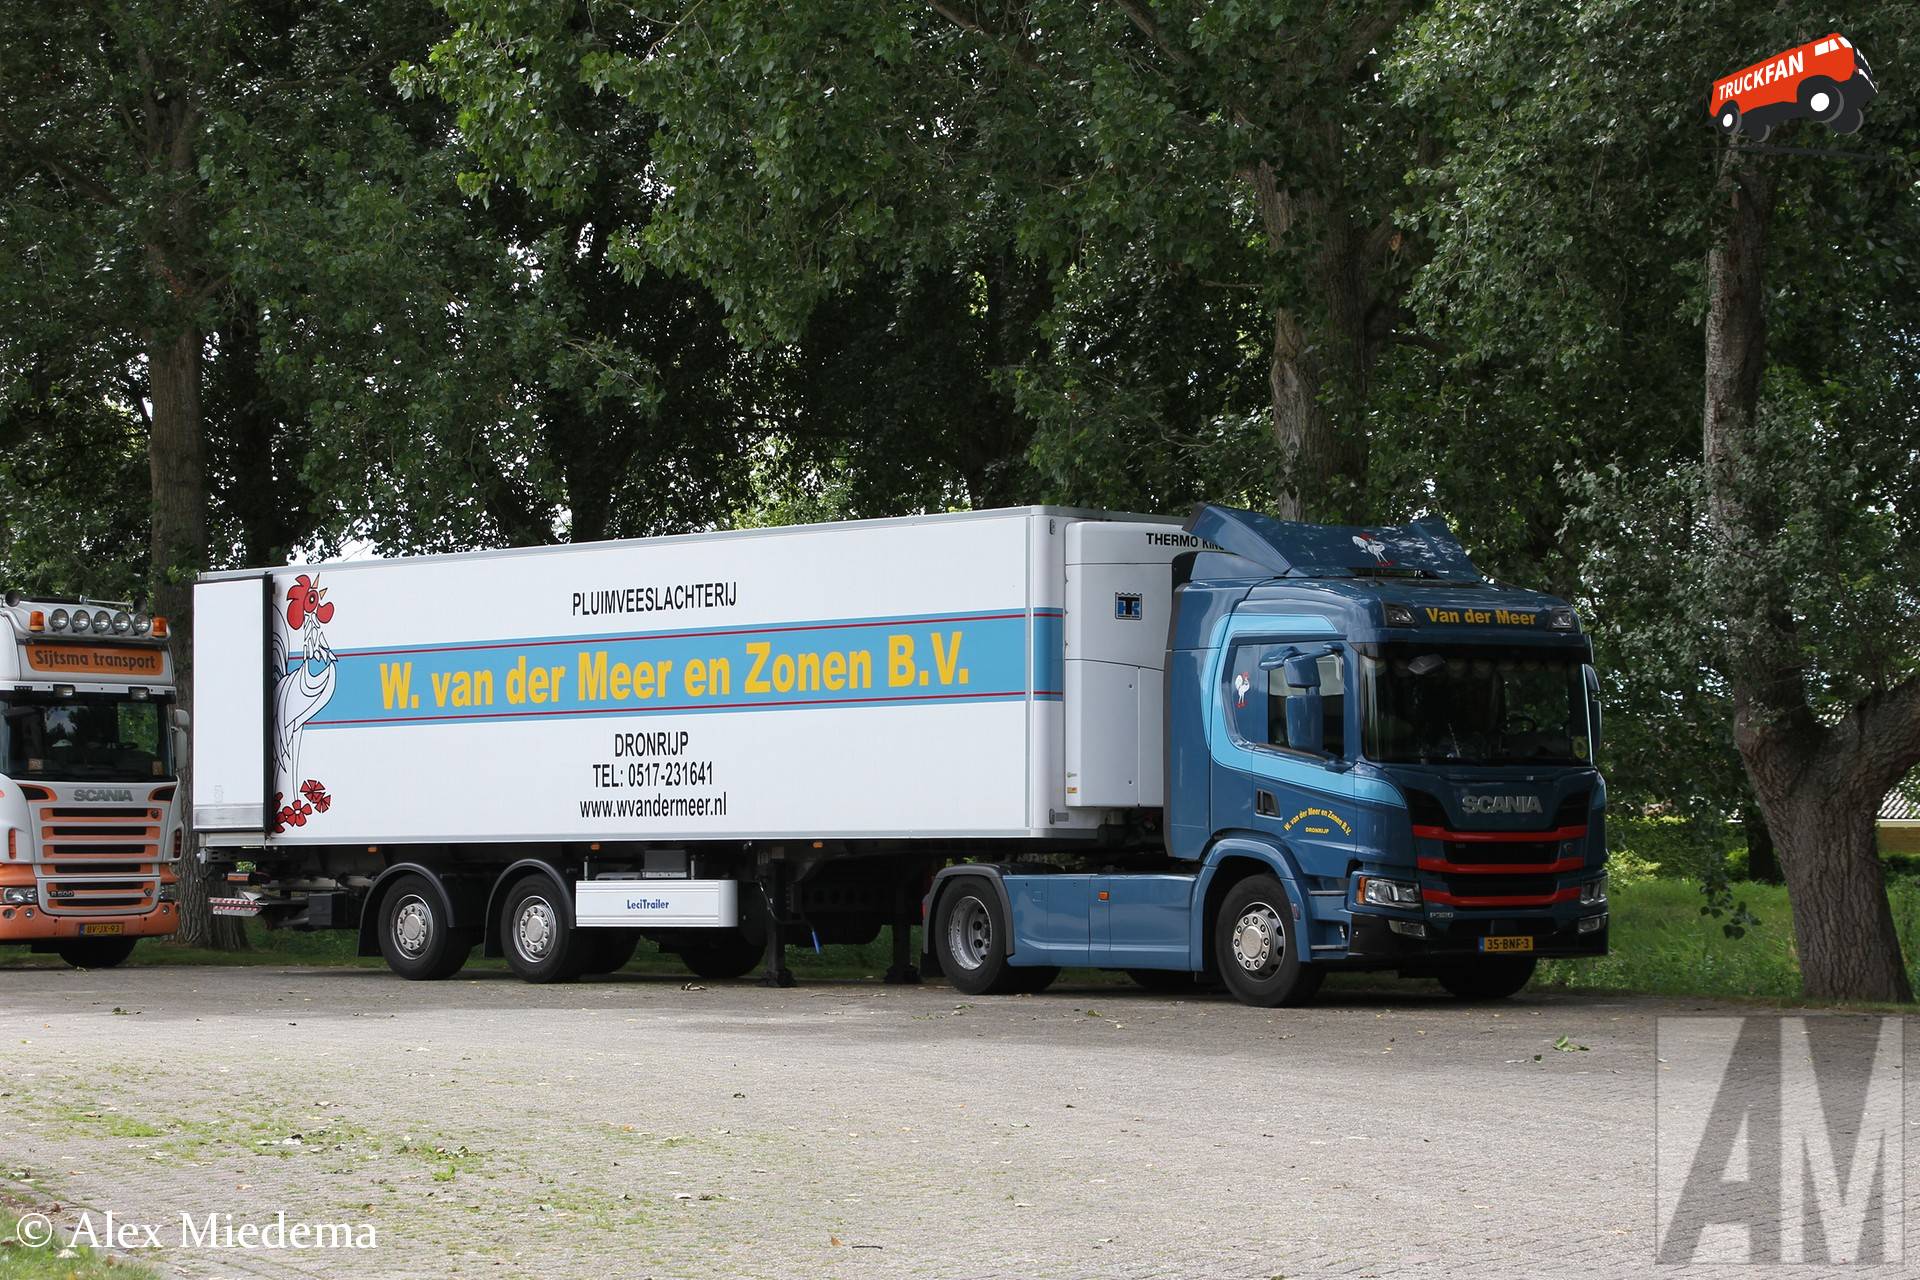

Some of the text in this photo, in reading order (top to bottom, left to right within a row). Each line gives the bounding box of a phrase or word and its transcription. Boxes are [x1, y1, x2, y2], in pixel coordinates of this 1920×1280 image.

[1146, 533, 1198, 548] THERMO
[572, 581, 737, 616] PLUIMVEESLACHTERIJ
[1426, 607, 1536, 625] Van der Meer
[34, 650, 156, 671] Sijtsma transport
[379, 631, 969, 709] W. van der Meer en Zonen B.V.
[614, 731, 689, 757] DRONRIJP
[592, 761, 713, 788] TEL: 0517-231641
[73, 789, 134, 802] SCANIA
[579, 792, 727, 818] www.wvandermeer.nl
[1462, 795, 1543, 814] SCANIA
[1308, 807, 1320, 816] Meer
[1320, 809, 1328, 817] en
[1328, 810, 1343, 826] Zonen
[627, 899, 669, 909] LeciTrailer
[1487, 938, 1530, 950] 35-BNF-3
